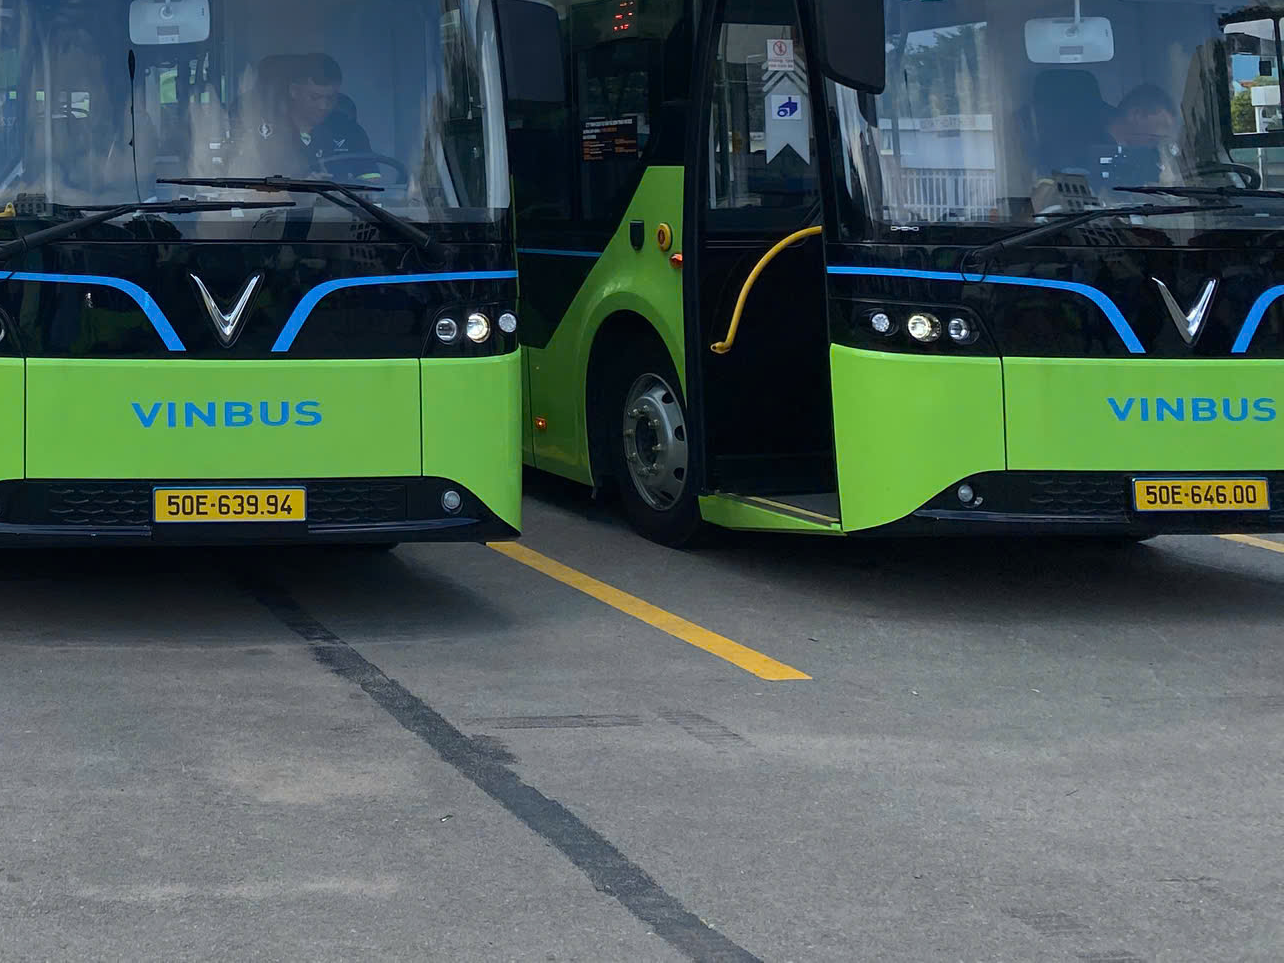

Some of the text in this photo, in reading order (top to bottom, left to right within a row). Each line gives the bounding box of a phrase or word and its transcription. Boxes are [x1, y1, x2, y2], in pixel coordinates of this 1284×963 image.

[131, 400, 323, 428] VINBUS
[1107, 397, 1277, 422] VINBUS
[167, 494, 293, 516] 50E-639.94
[1145, 485, 1257, 505] 50E-646.00
